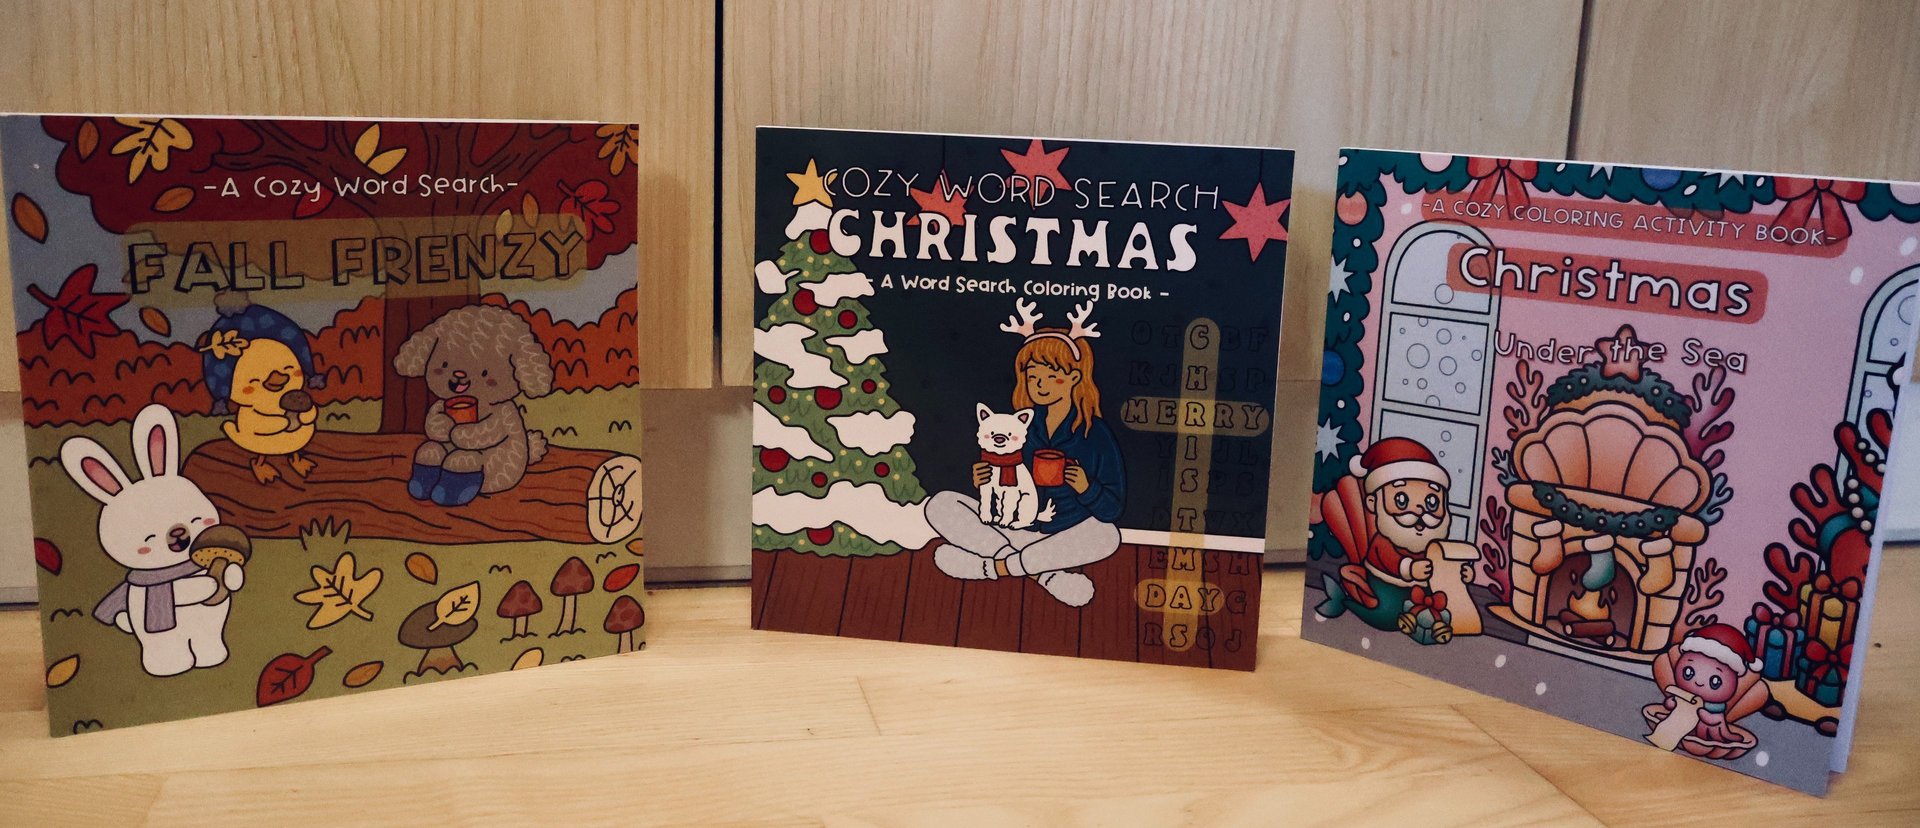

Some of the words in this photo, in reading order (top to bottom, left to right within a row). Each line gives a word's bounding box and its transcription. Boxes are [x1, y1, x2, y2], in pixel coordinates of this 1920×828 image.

[254, 175, 322, 202] Cozy
[333, 174, 408, 198] Word
[823, 166, 920, 199] COZY
[939, 171, 1055, 207] WORD
[1074, 177, 1220, 212] SEARCH
[827, 207, 1199, 274] CHRISTMAS
[1453, 200, 1505, 219] COZY
[1513, 205, 1624, 230] COLORING
[1633, 214, 1747, 241] ACTIVITY
[126, 240, 304, 294] FALL
[331, 229, 584, 287] FRENZY
[1459, 246, 1754, 317] Christmas
[880, 274, 894, 290] A
[900, 274, 950, 292] Word
[956, 276, 1017, 294] Search
[1023, 279, 1100, 303] Coloring
[1107, 284, 1152, 302] Book
[1494, 329, 1596, 364] Under
[1610, 337, 1668, 364] the
[1681, 337, 1748, 375] Sea
